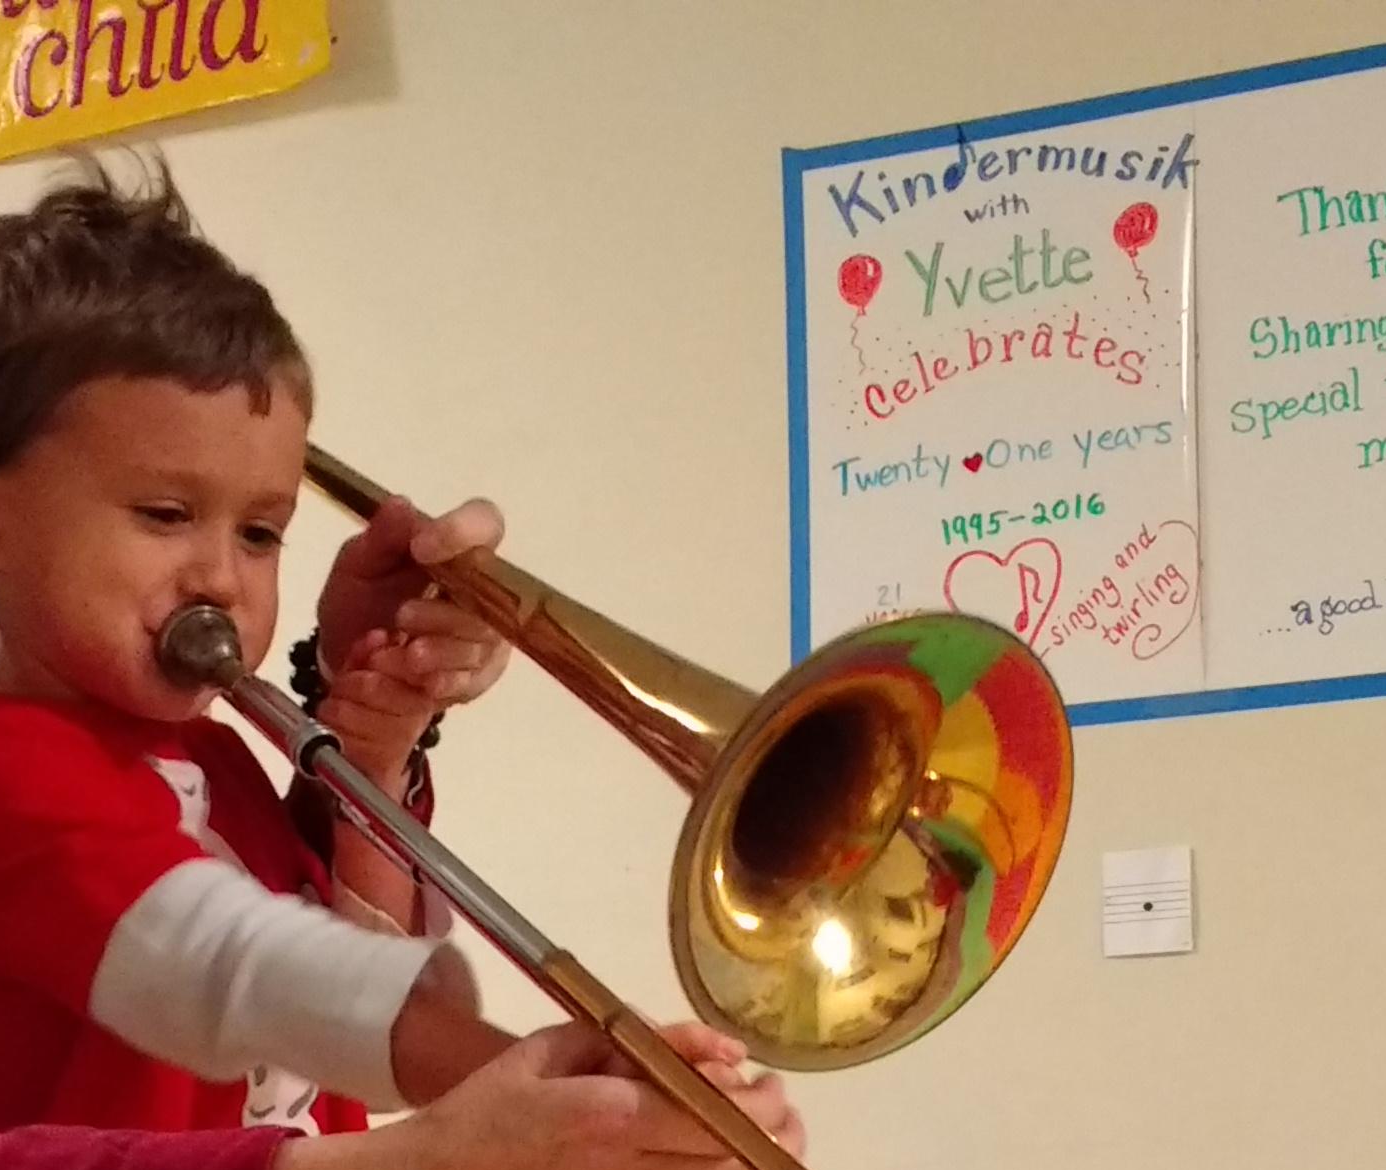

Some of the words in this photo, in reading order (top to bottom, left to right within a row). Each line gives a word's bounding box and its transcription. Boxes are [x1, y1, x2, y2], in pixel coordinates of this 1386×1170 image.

[963, 193, 1031, 224] with
[903, 228, 1094, 318] Yvette
[832, 444, 951, 497] Twenty
[986, 438, 1054, 469] One
[940, 493, 1107, 545] 1995-2016
[1050, 575, 1123, 647] singing
[1114, 523, 1158, 569] and
[1101, 562, 1191, 647] twirling
[1318, 579, 1382, 636] good
